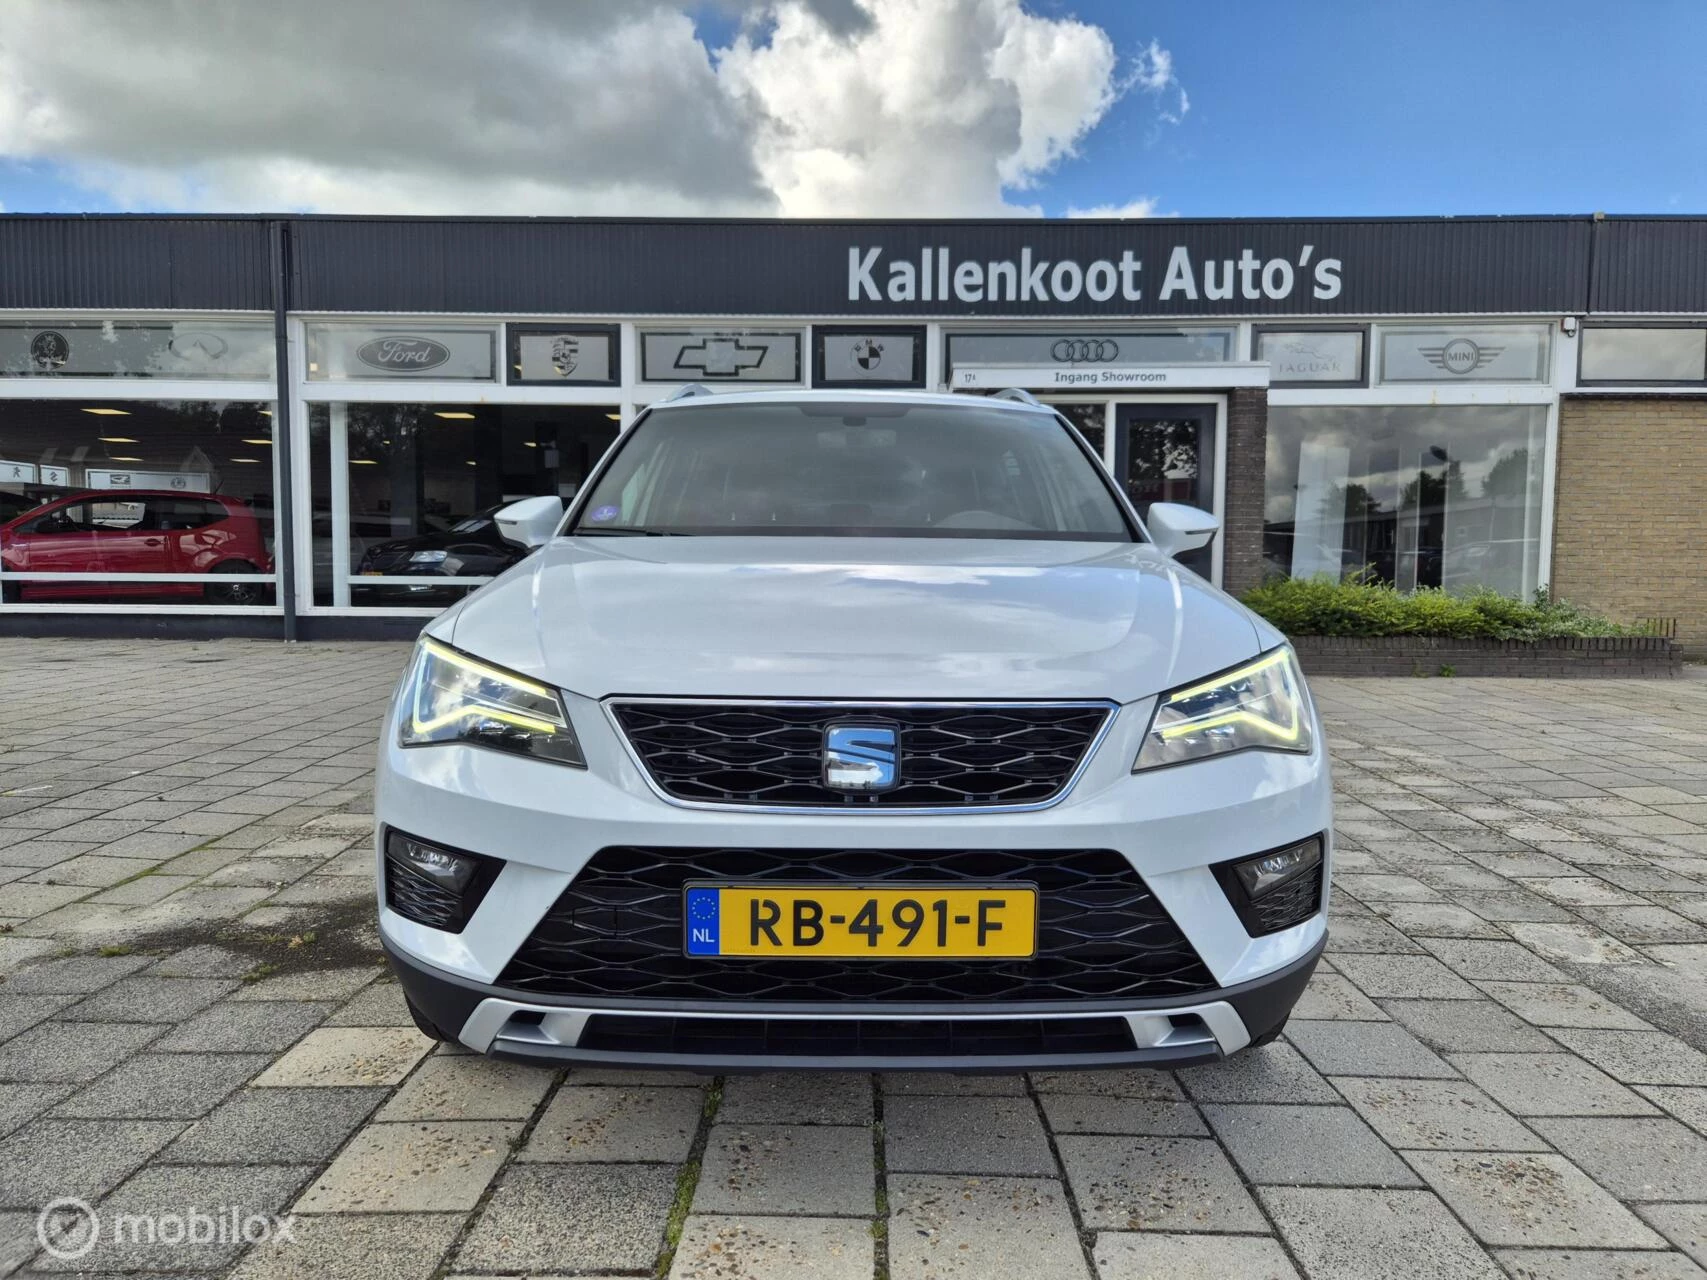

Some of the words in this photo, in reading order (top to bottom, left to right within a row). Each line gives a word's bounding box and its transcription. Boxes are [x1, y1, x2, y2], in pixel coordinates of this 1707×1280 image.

[848, 246, 1142, 302] Kallenkoot
[1159, 245, 1343, 300] Auto's
[378, 340, 431, 362] Ford
[1447, 352, 1474, 361] MINI
[1055, 372, 1098, 384] Ingang
[1101, 371, 1167, 382] Showroom
[750, 899, 1006, 947] RB-491-F
[692, 928, 715, 943] NL
